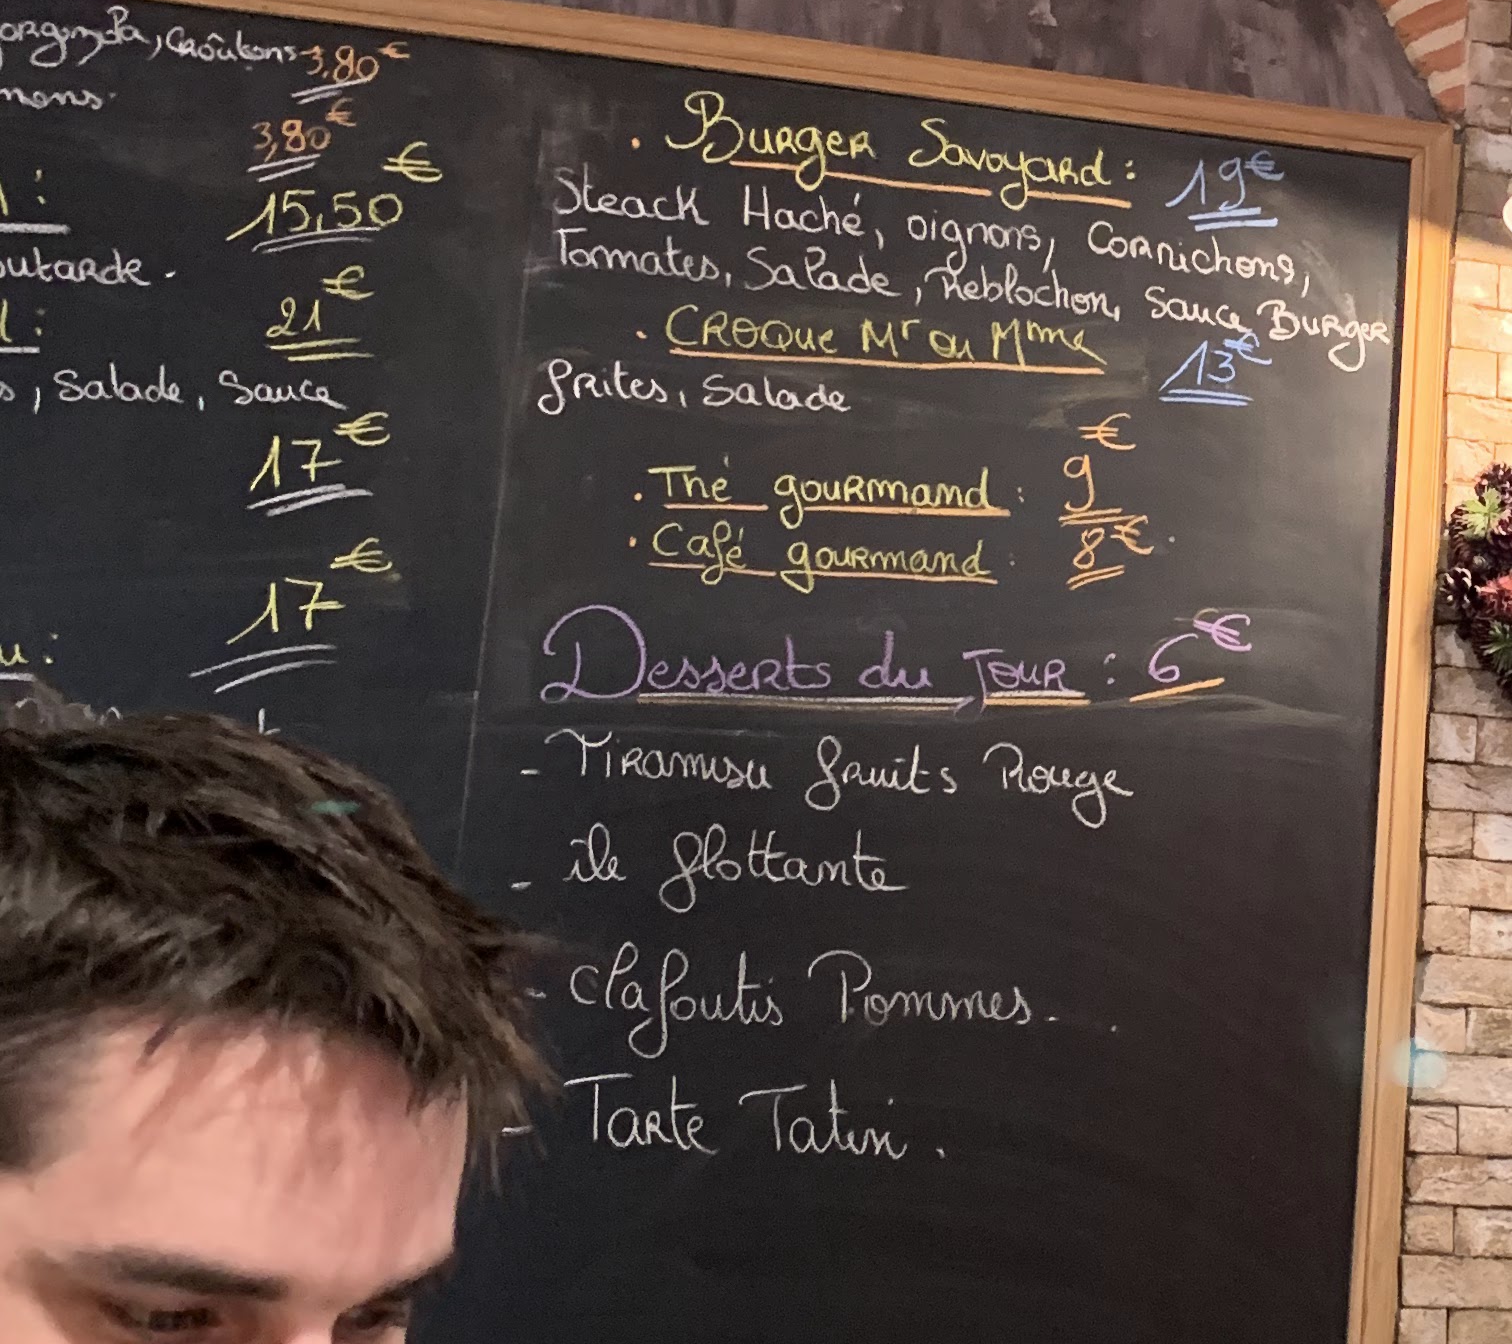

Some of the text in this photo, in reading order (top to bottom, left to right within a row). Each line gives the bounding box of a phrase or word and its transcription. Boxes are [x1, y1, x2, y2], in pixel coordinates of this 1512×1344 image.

[665, 90, 877, 192] Burger
[554, 163, 710, 226] Steack
[218, 370, 348, 410] Sauce
[540, 603, 831, 704] Desserts
[858, 630, 932, 690] du
